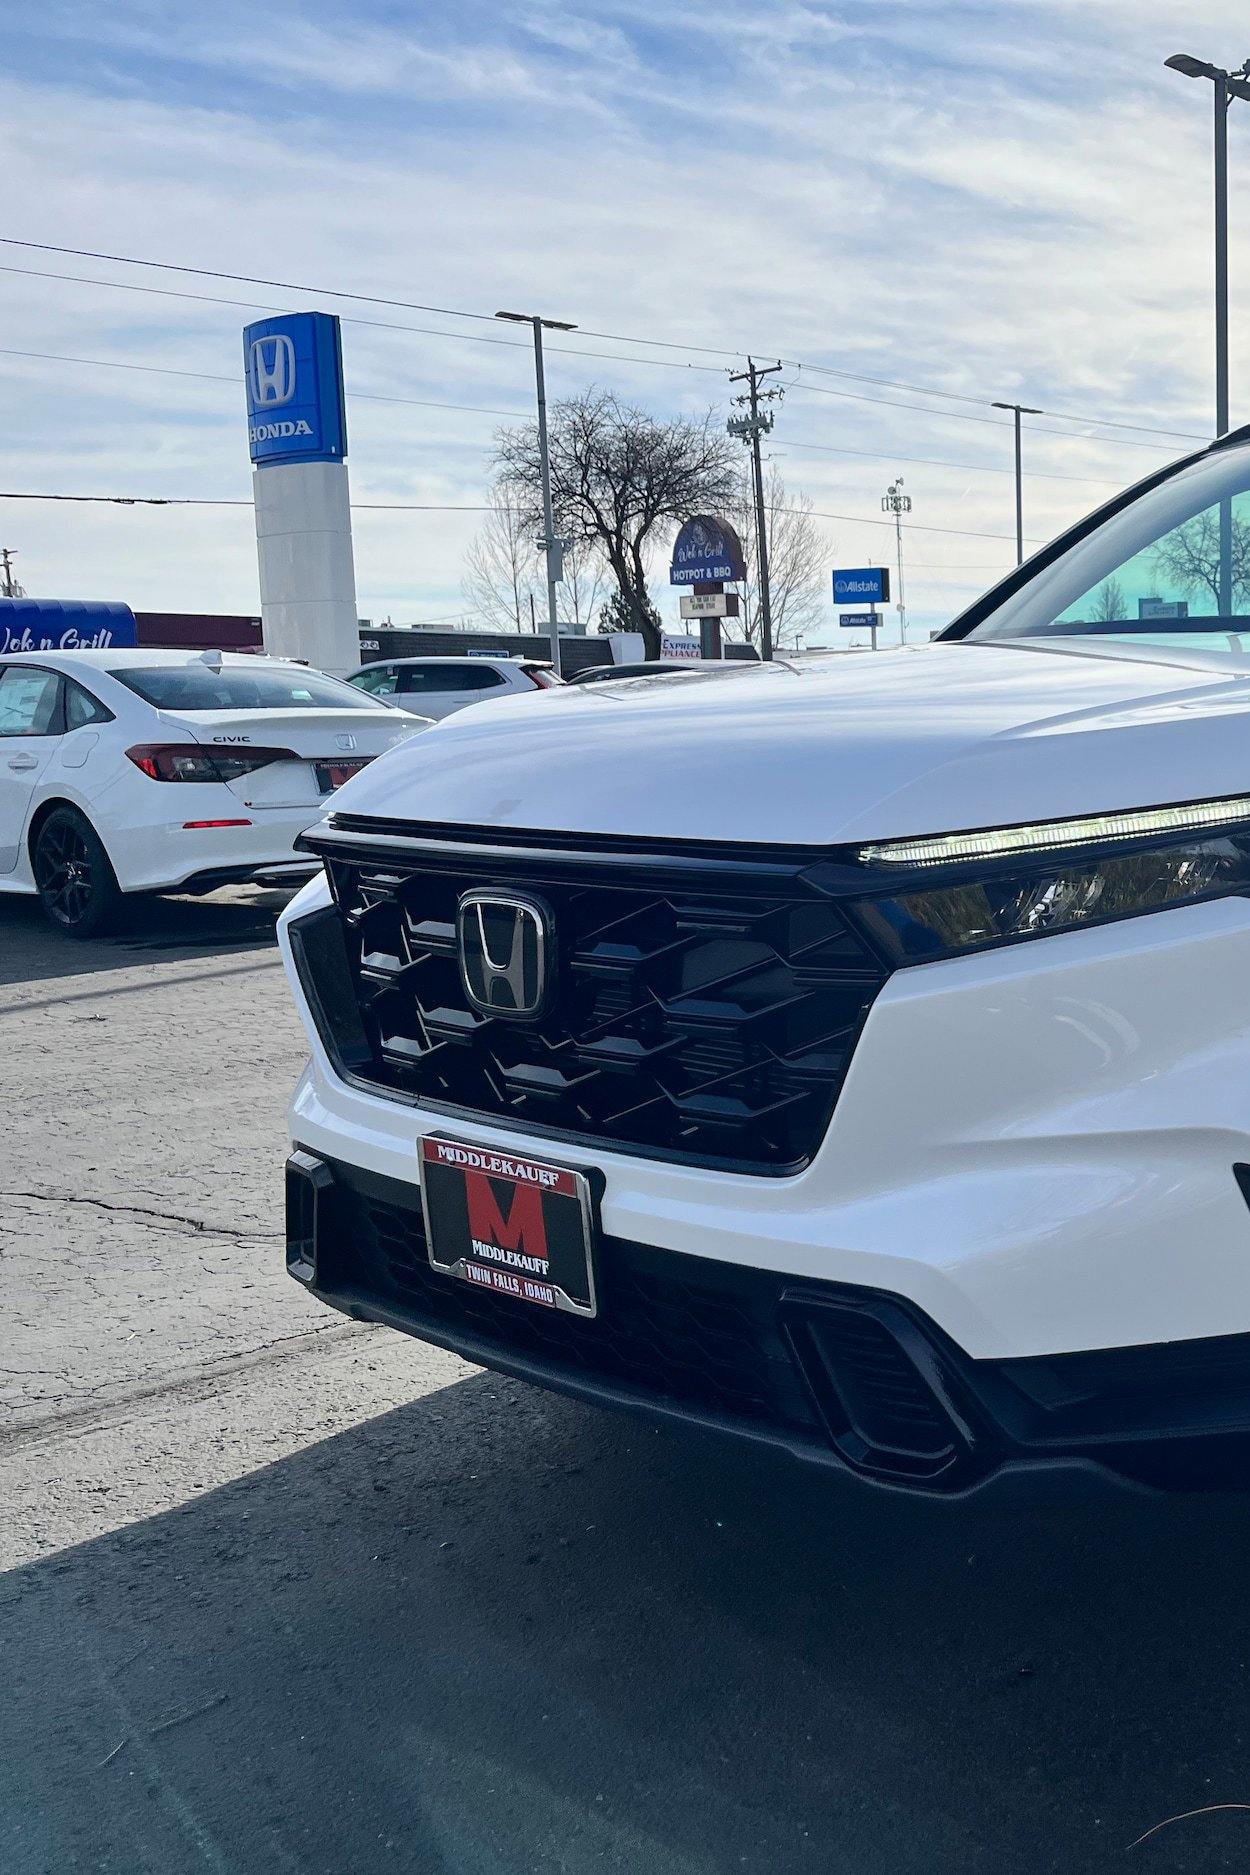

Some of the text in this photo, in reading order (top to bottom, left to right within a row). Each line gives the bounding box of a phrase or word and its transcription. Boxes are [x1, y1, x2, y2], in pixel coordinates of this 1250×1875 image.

[250, 420, 313, 443] HONDA
[674, 566, 731, 580] HOTPOT & BBQ
[846, 581, 879, 592] Allstate
[40, 638, 53, 650] n
[60, 628, 113, 649] Grill
[437, 1145, 560, 1187] MIDDLEKAUFF
[465, 1170, 549, 1259] M
[471, 1239, 550, 1276] MIDDLEKAUFF
[466, 1264, 553, 1303] TWIN FALLS, IDAHO
